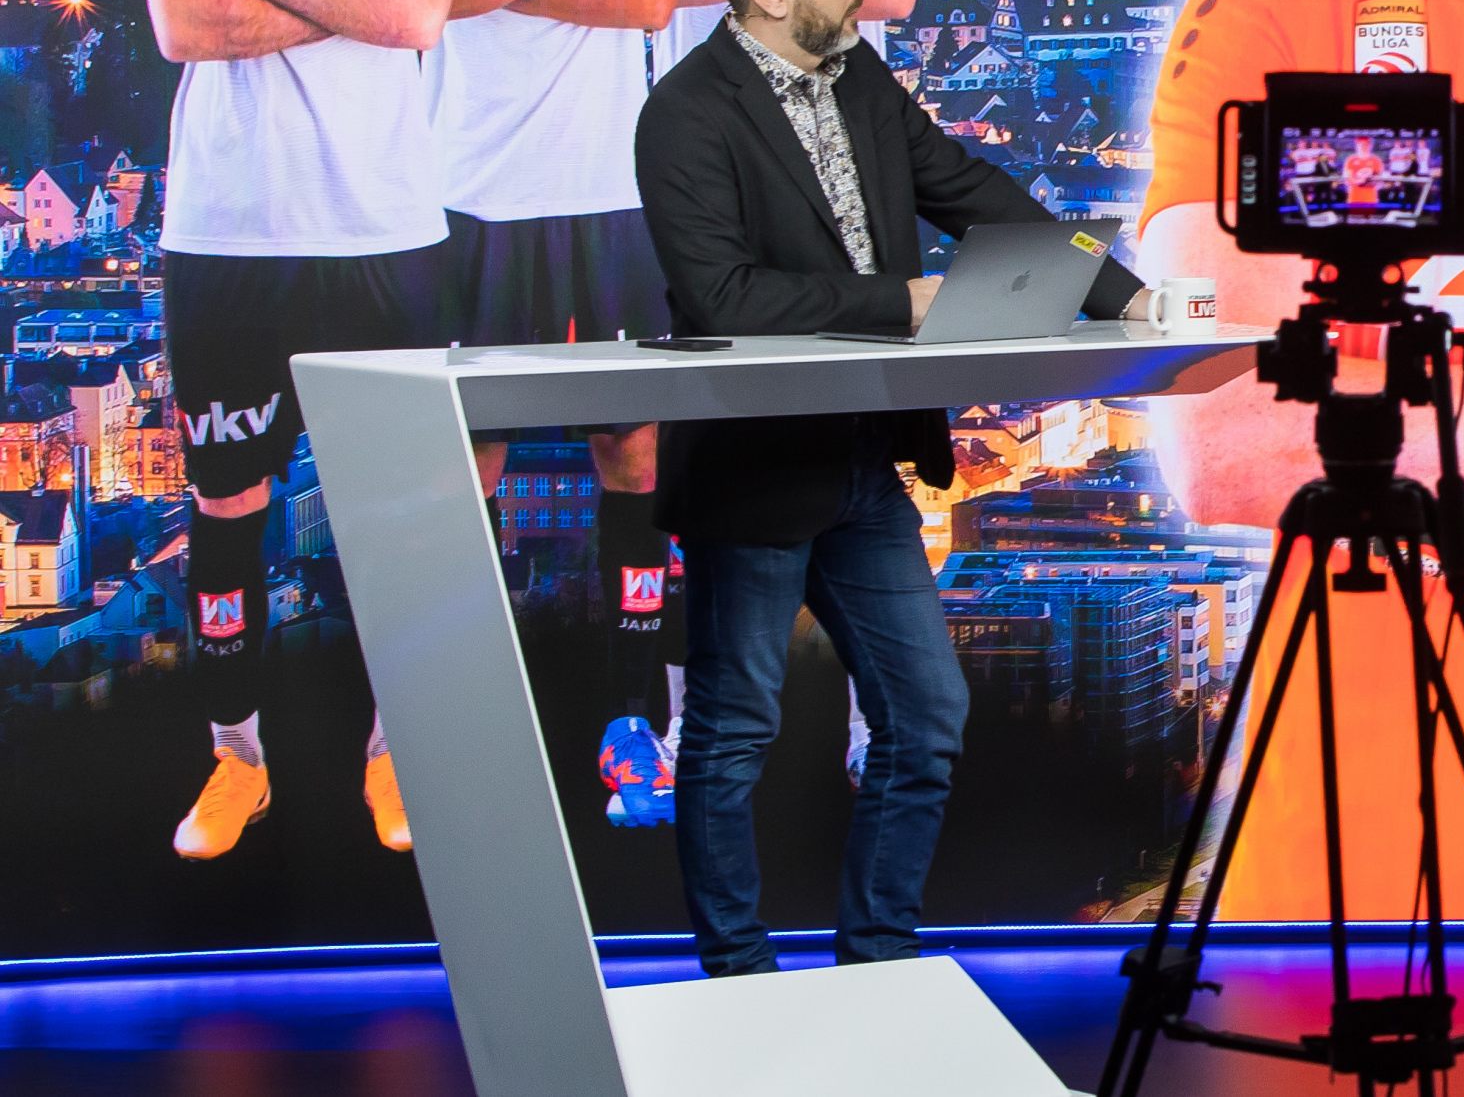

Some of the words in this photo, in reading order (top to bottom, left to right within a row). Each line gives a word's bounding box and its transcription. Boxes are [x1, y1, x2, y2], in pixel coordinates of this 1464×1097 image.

[1360, 5, 1425, 16] ADMIRAL
[1358, 25, 1425, 38] BUNDES
[1372, 38, 1409, 49] LIGA
[624, 569, 664, 599] VN
[202, 593, 242, 624] VN
[618, 617, 662, 631] JAKO
